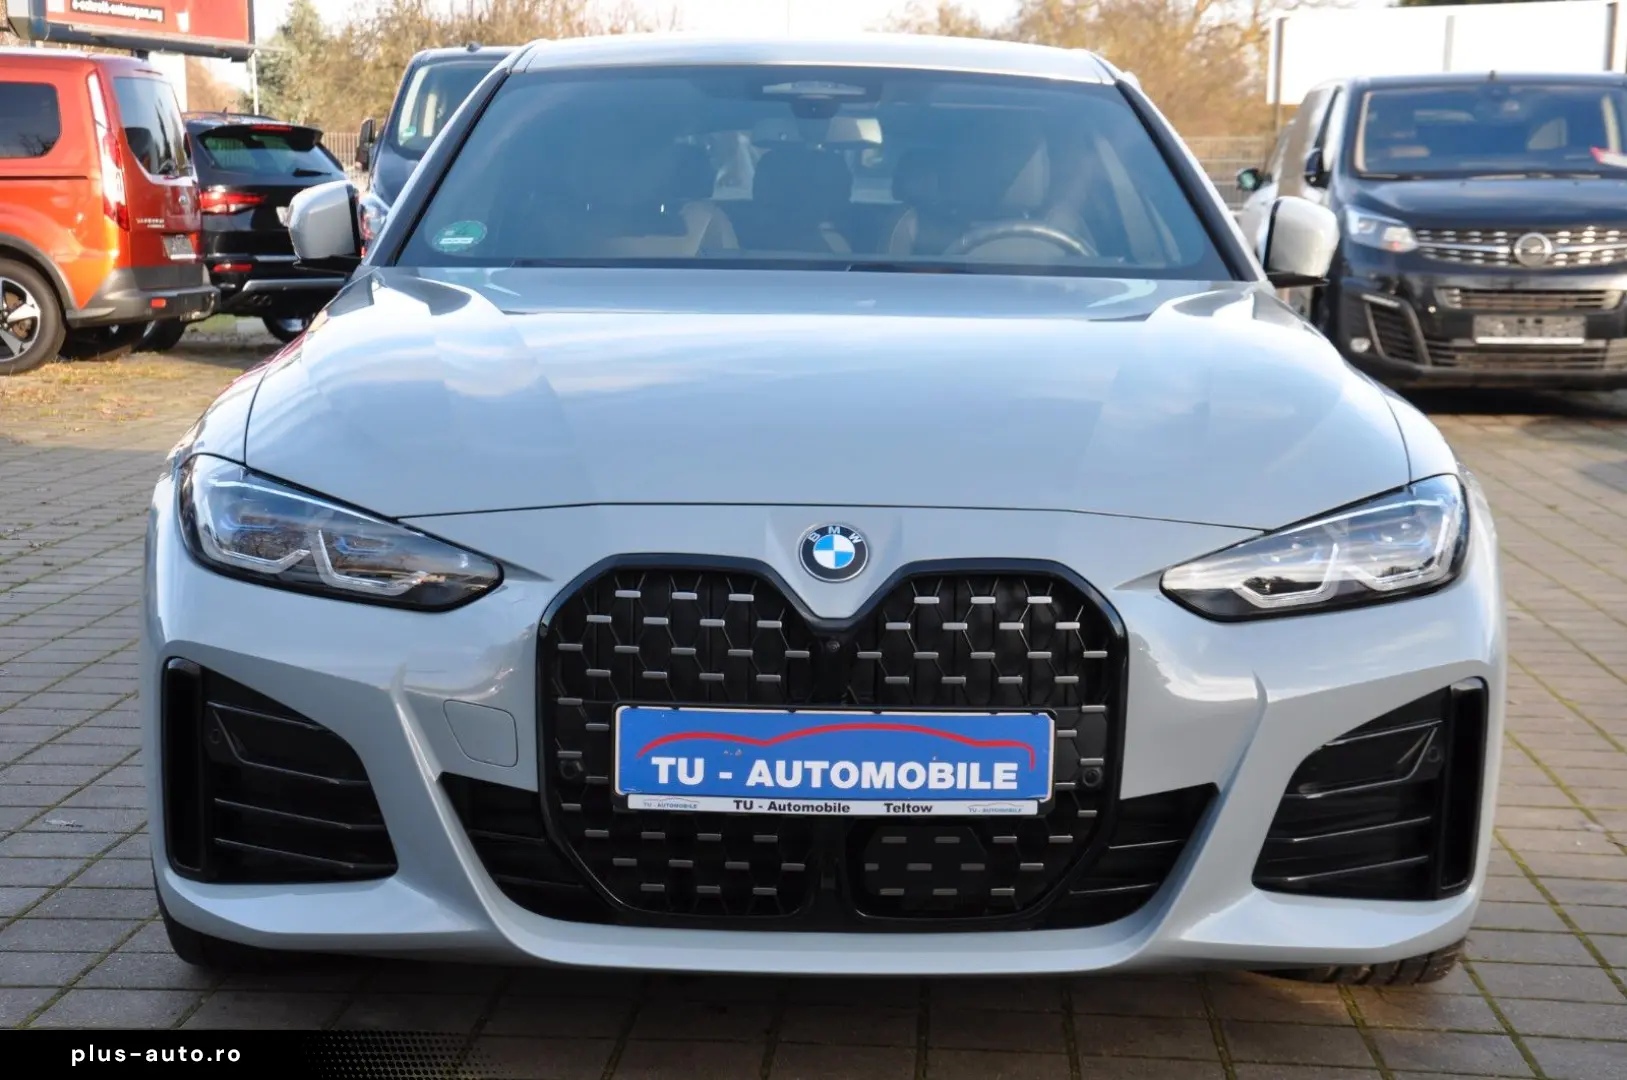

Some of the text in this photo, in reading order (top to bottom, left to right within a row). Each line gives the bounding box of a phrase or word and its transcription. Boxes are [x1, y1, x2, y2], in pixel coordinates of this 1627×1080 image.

[808, 526, 862, 544] BMW
[651, 756, 1019, 790] TU - AUTOMOBILE
[733, 800, 754, 811] TU
[767, 801, 851, 813] Automobile
[884, 802, 933, 813] Teltow
